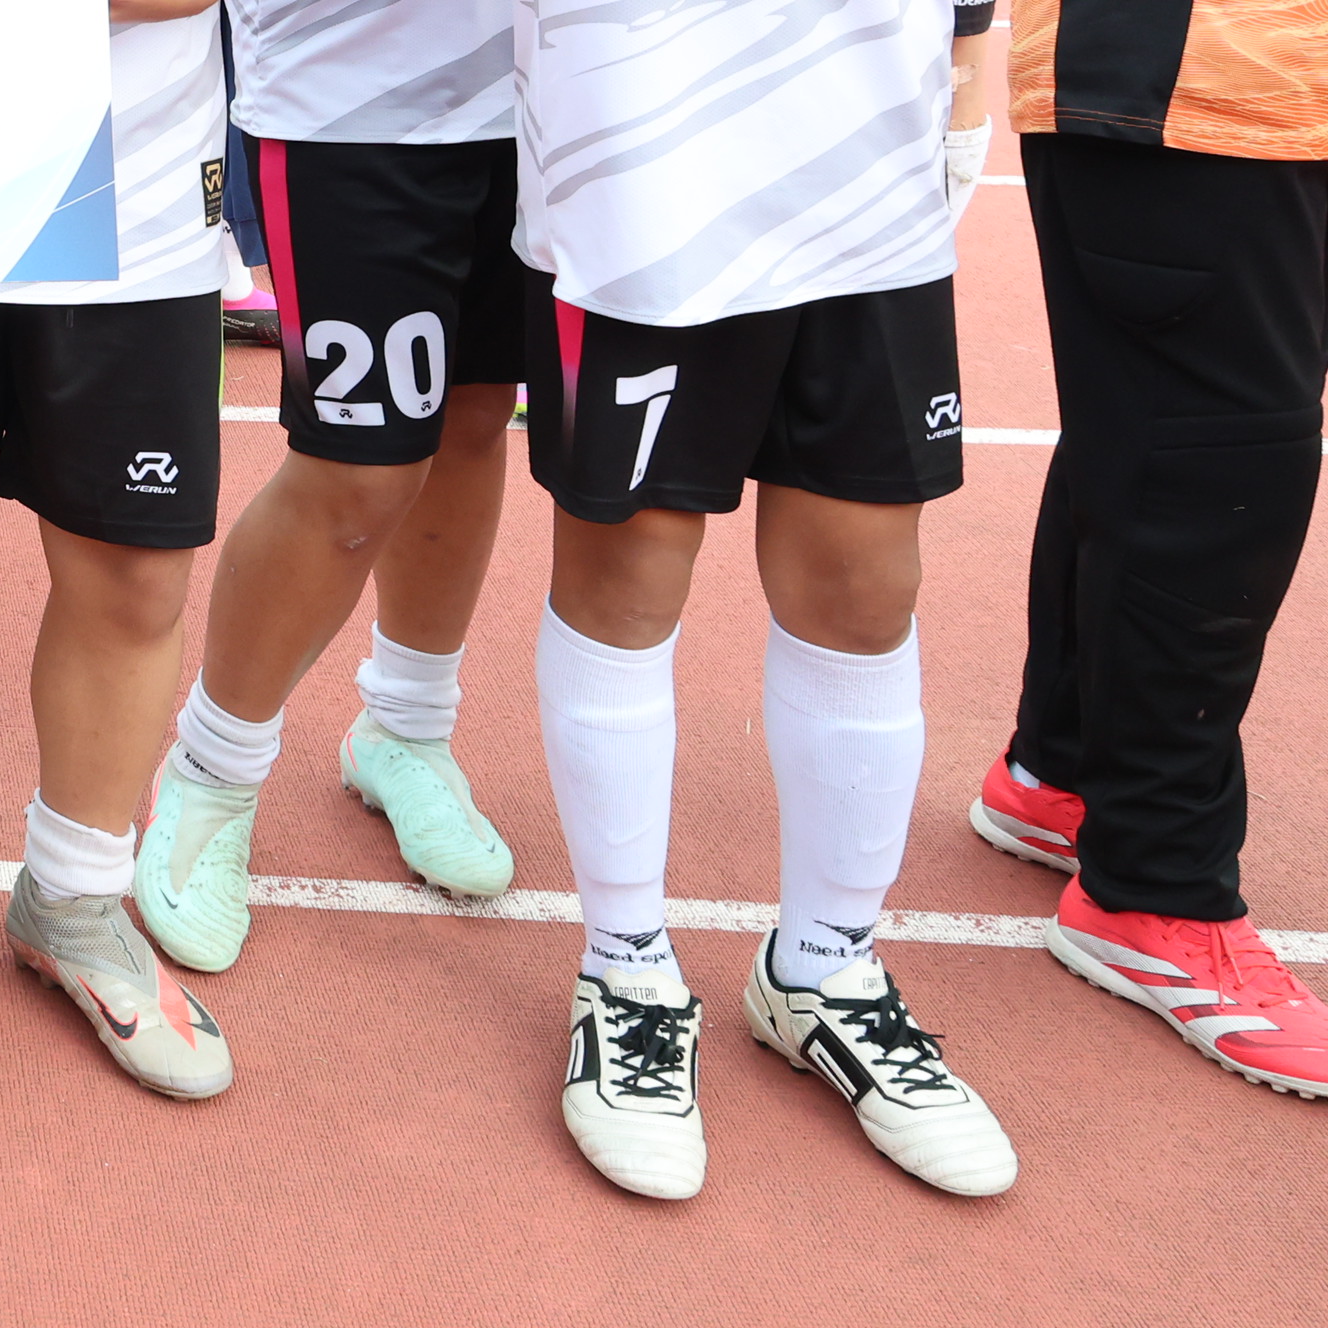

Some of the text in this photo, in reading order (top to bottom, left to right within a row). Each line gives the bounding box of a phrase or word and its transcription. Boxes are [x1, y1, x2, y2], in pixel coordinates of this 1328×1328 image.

[305, 310, 446, 425] 20
[614, 365, 678, 491] 7
[125, 482, 178, 495] WERUN
[799, 940, 847, 958] Need
